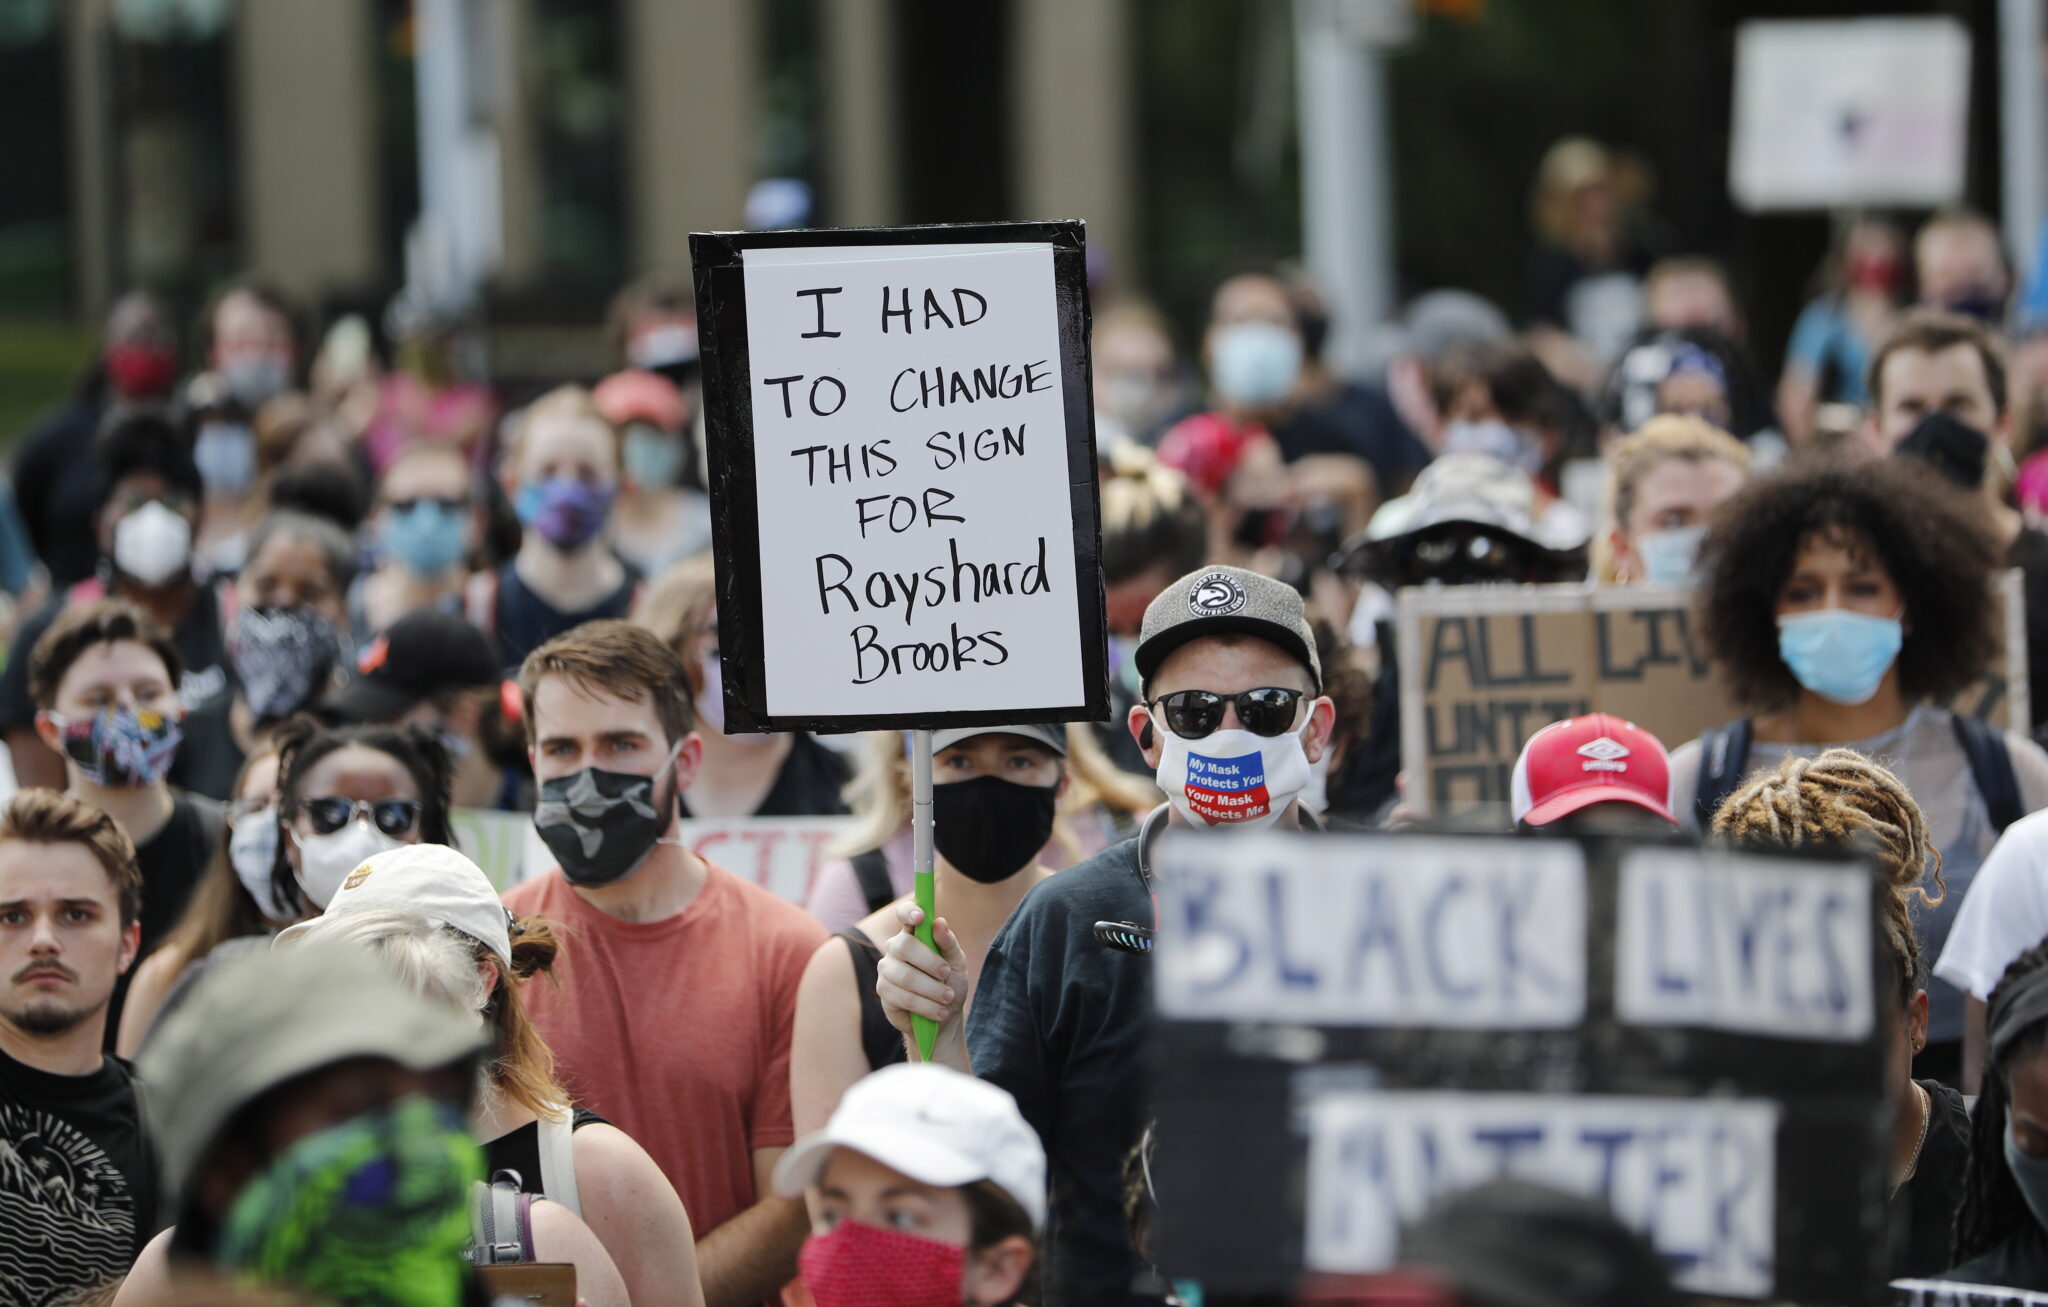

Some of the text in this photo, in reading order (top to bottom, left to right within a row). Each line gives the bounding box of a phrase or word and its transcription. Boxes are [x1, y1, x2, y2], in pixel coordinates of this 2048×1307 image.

[796, 286, 988, 339] I HAD
[763, 359, 1054, 419] TO CHANGE
[790, 423, 1026, 487] THIS SIGN
[855, 488, 966, 538] FOR
[815, 536, 1051, 625] Rayshard
[1220, 574, 1242, 592] HAWKS
[850, 622, 1009, 685] Brooks
[1425, 607, 1710, 690] ALL LIV
[1188, 757, 1240, 775] My Mask
[1189, 771, 1264, 790] Protects You
[1186, 787, 1254, 807] Your Mask
[1188, 799, 1265, 820] Protects Me
[1166, 866, 1853, 1018] BLACK LIVES
